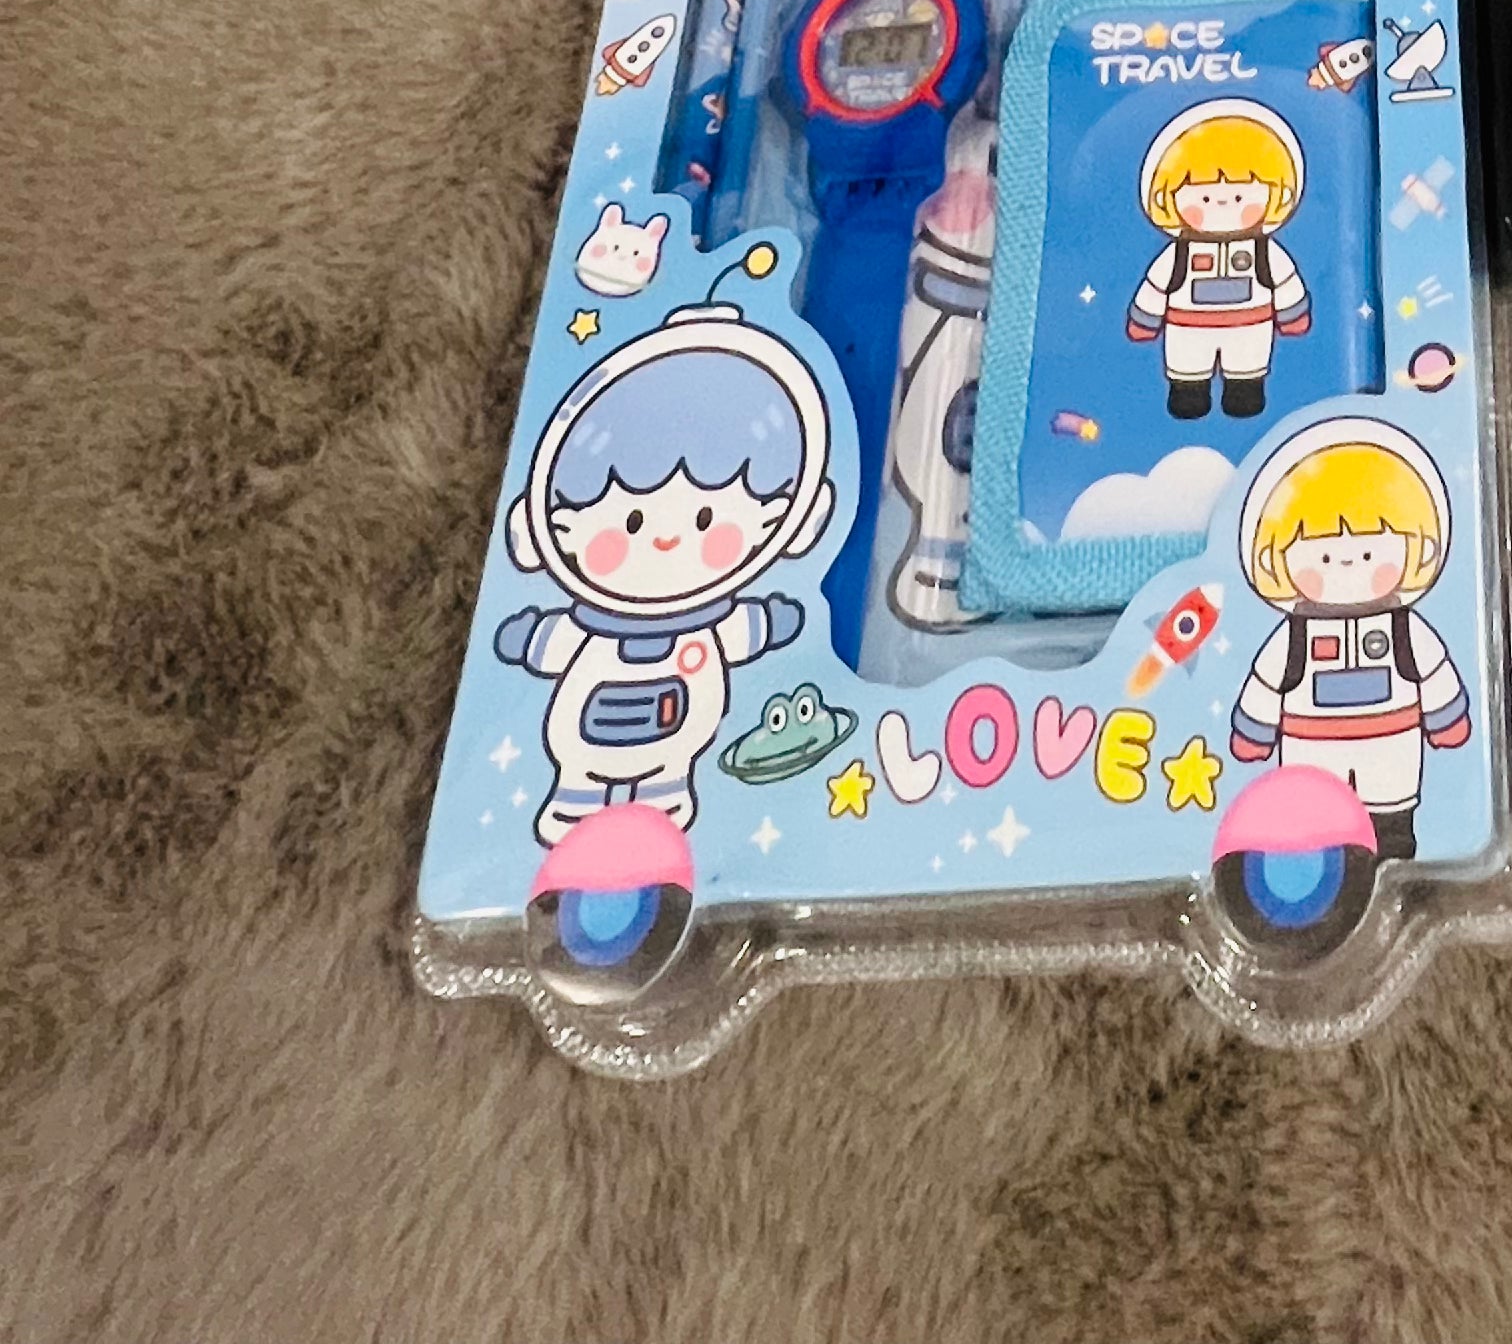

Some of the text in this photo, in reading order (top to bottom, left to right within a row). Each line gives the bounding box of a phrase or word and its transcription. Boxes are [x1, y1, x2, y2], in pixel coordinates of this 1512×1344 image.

[1089, 20, 1226, 51] SPCE
[1092, 50, 1259, 86] TRAVEL
[876, 683, 1157, 804] LOVE
